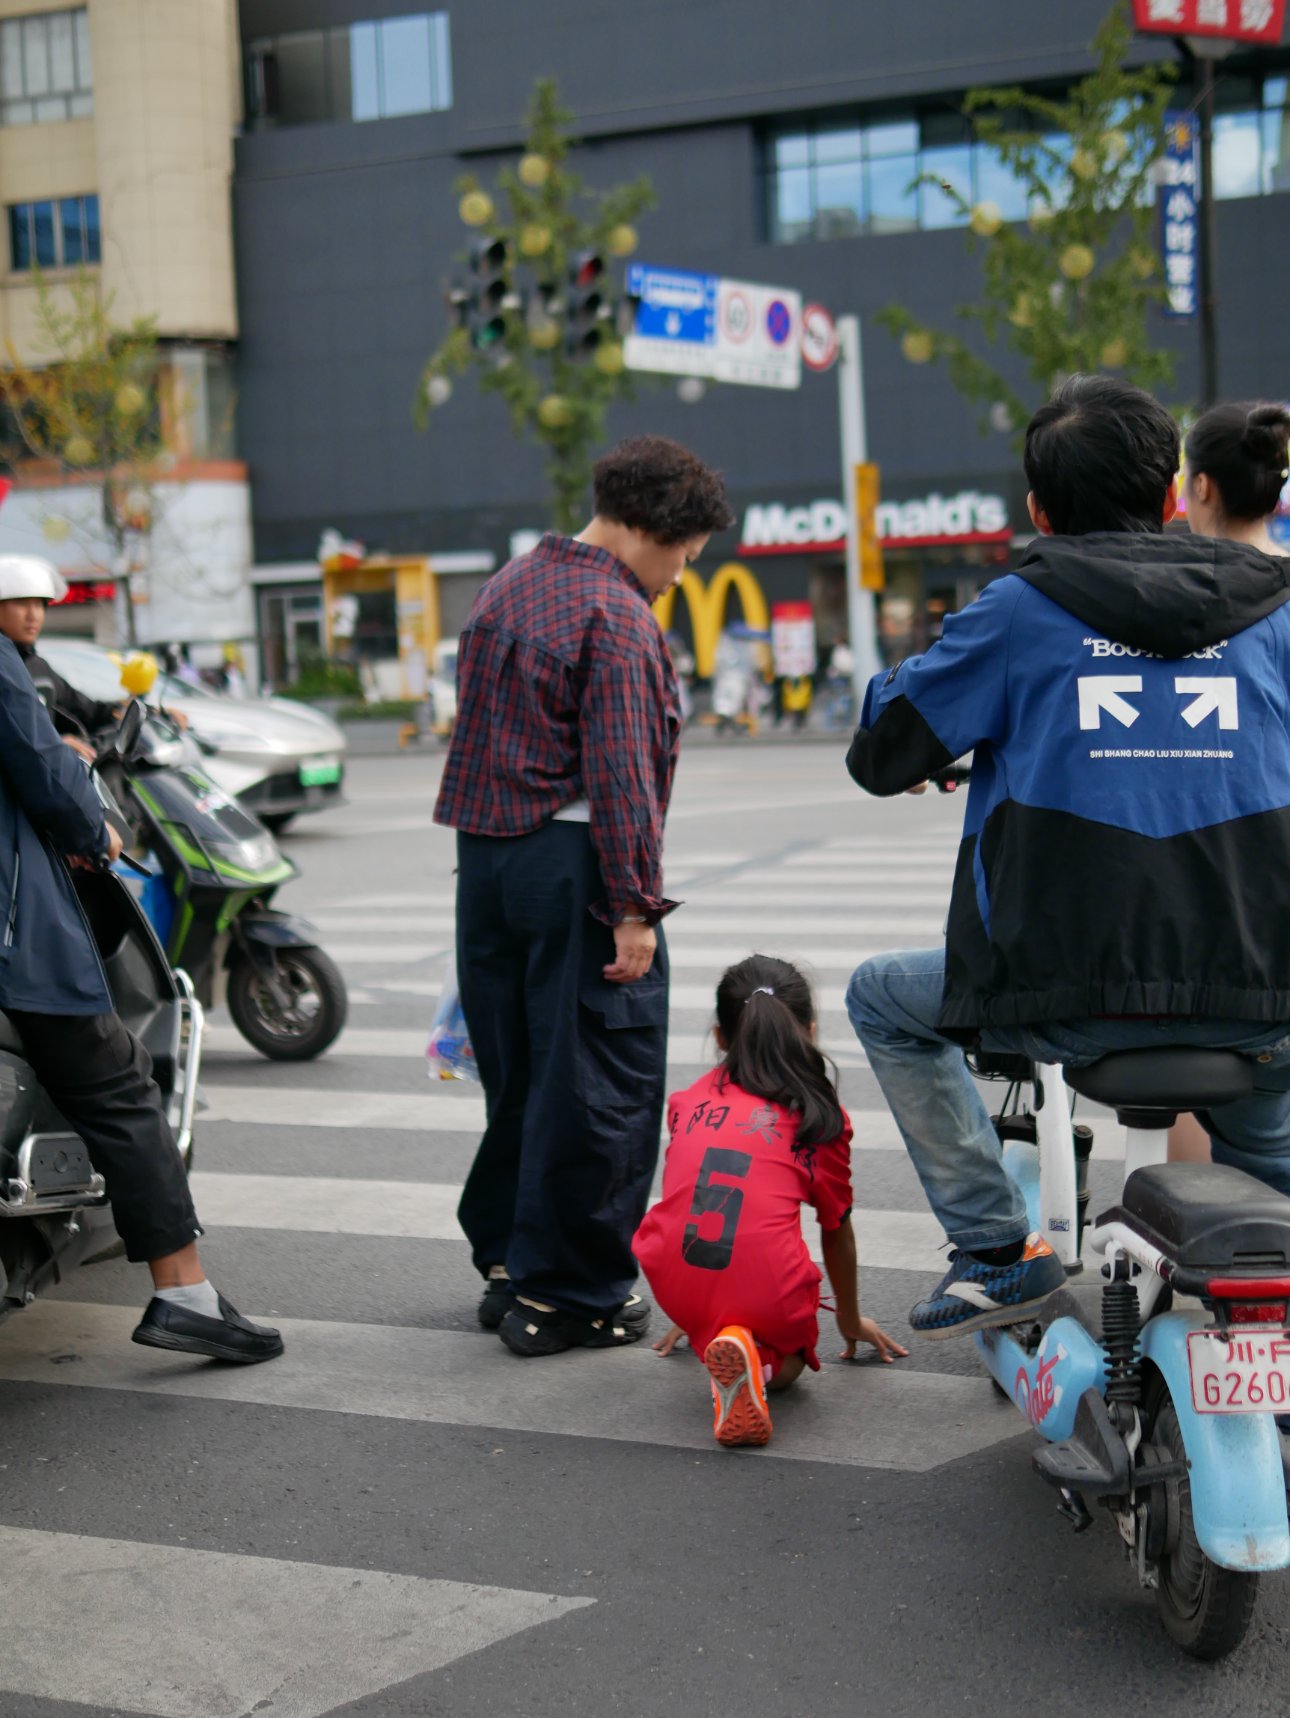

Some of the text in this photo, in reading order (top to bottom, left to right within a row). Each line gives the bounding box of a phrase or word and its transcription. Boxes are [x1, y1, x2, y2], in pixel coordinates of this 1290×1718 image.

[741, 490, 1007, 547] McDnald's
[1090, 749, 1234, 759] SHI SHANG CHAO LIU XIU XIAN ZHUANG
[682, 1147, 752, 1271] 5
[1203, 1370, 1290, 1406] G260
